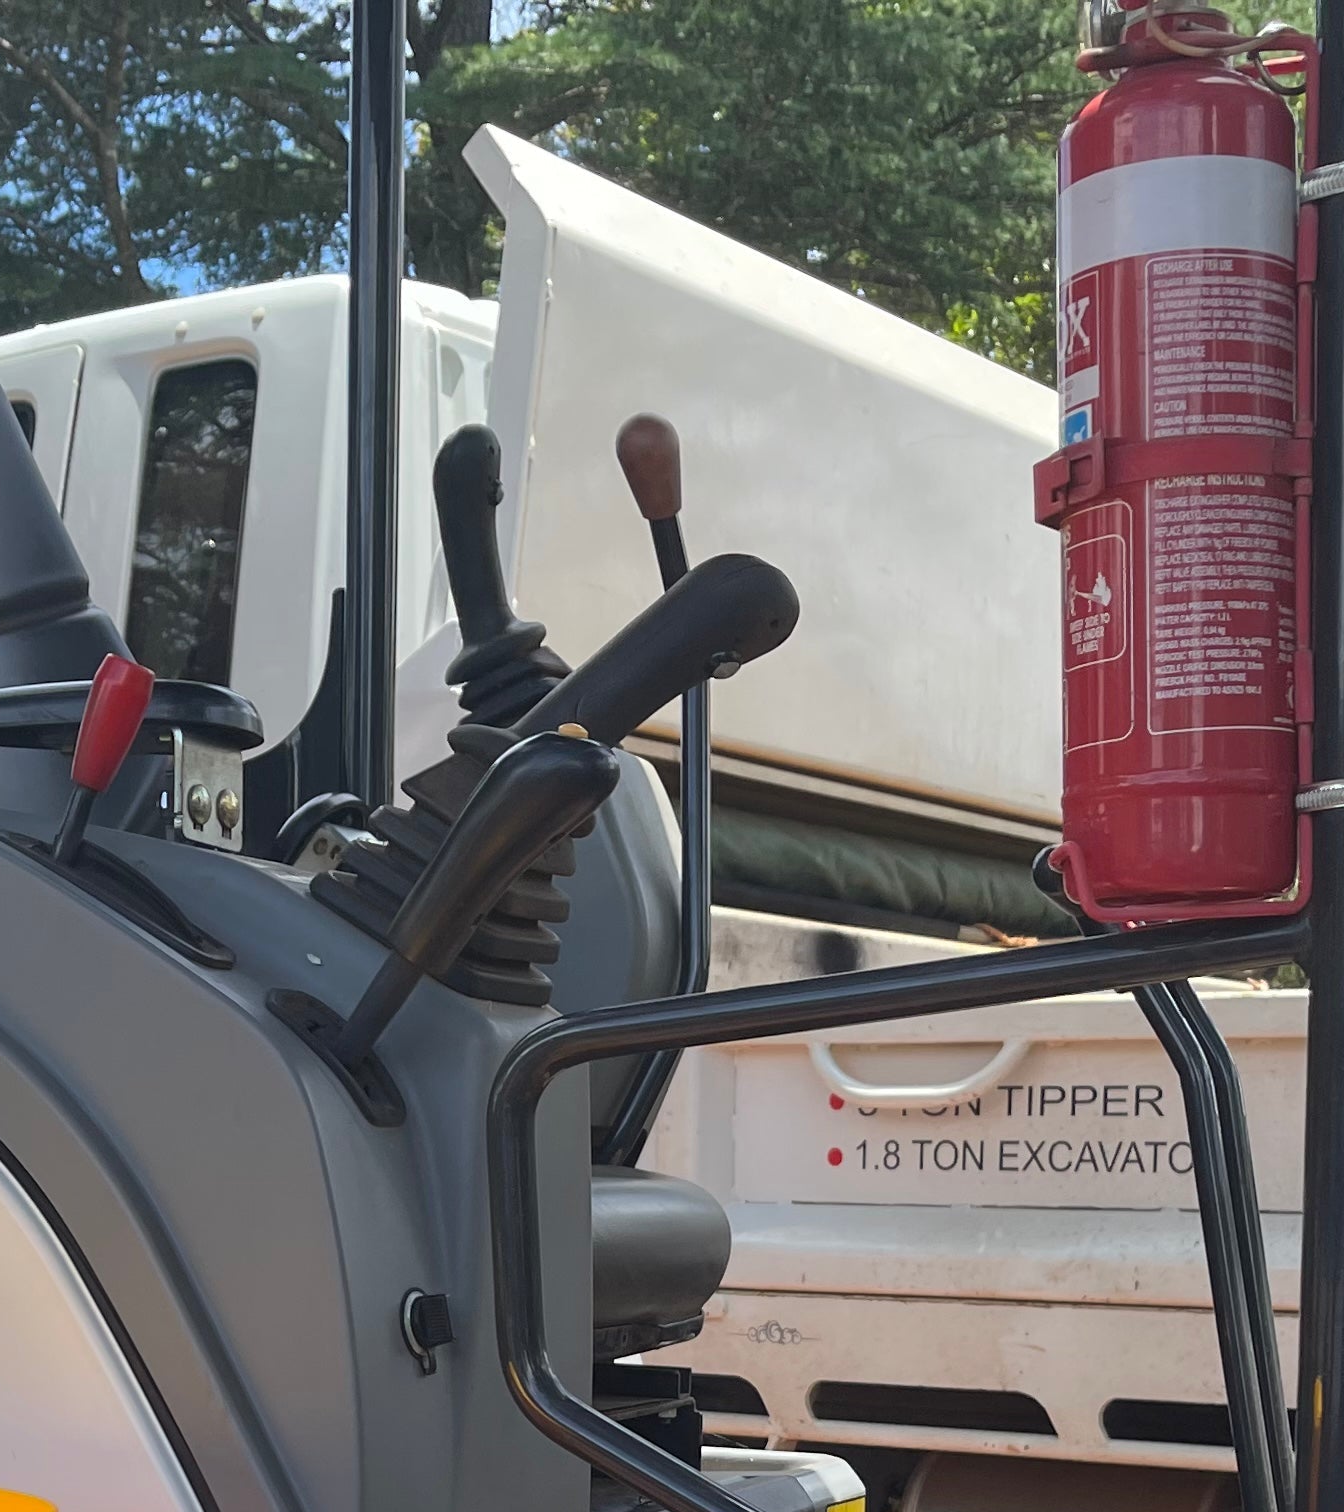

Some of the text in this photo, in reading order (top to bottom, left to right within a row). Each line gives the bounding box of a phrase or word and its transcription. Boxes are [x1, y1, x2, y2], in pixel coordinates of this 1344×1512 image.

[997, 1084, 1165, 1117] TIPPER
[856, 1139, 1195, 1175] 1.8 TON EXCAVATO
